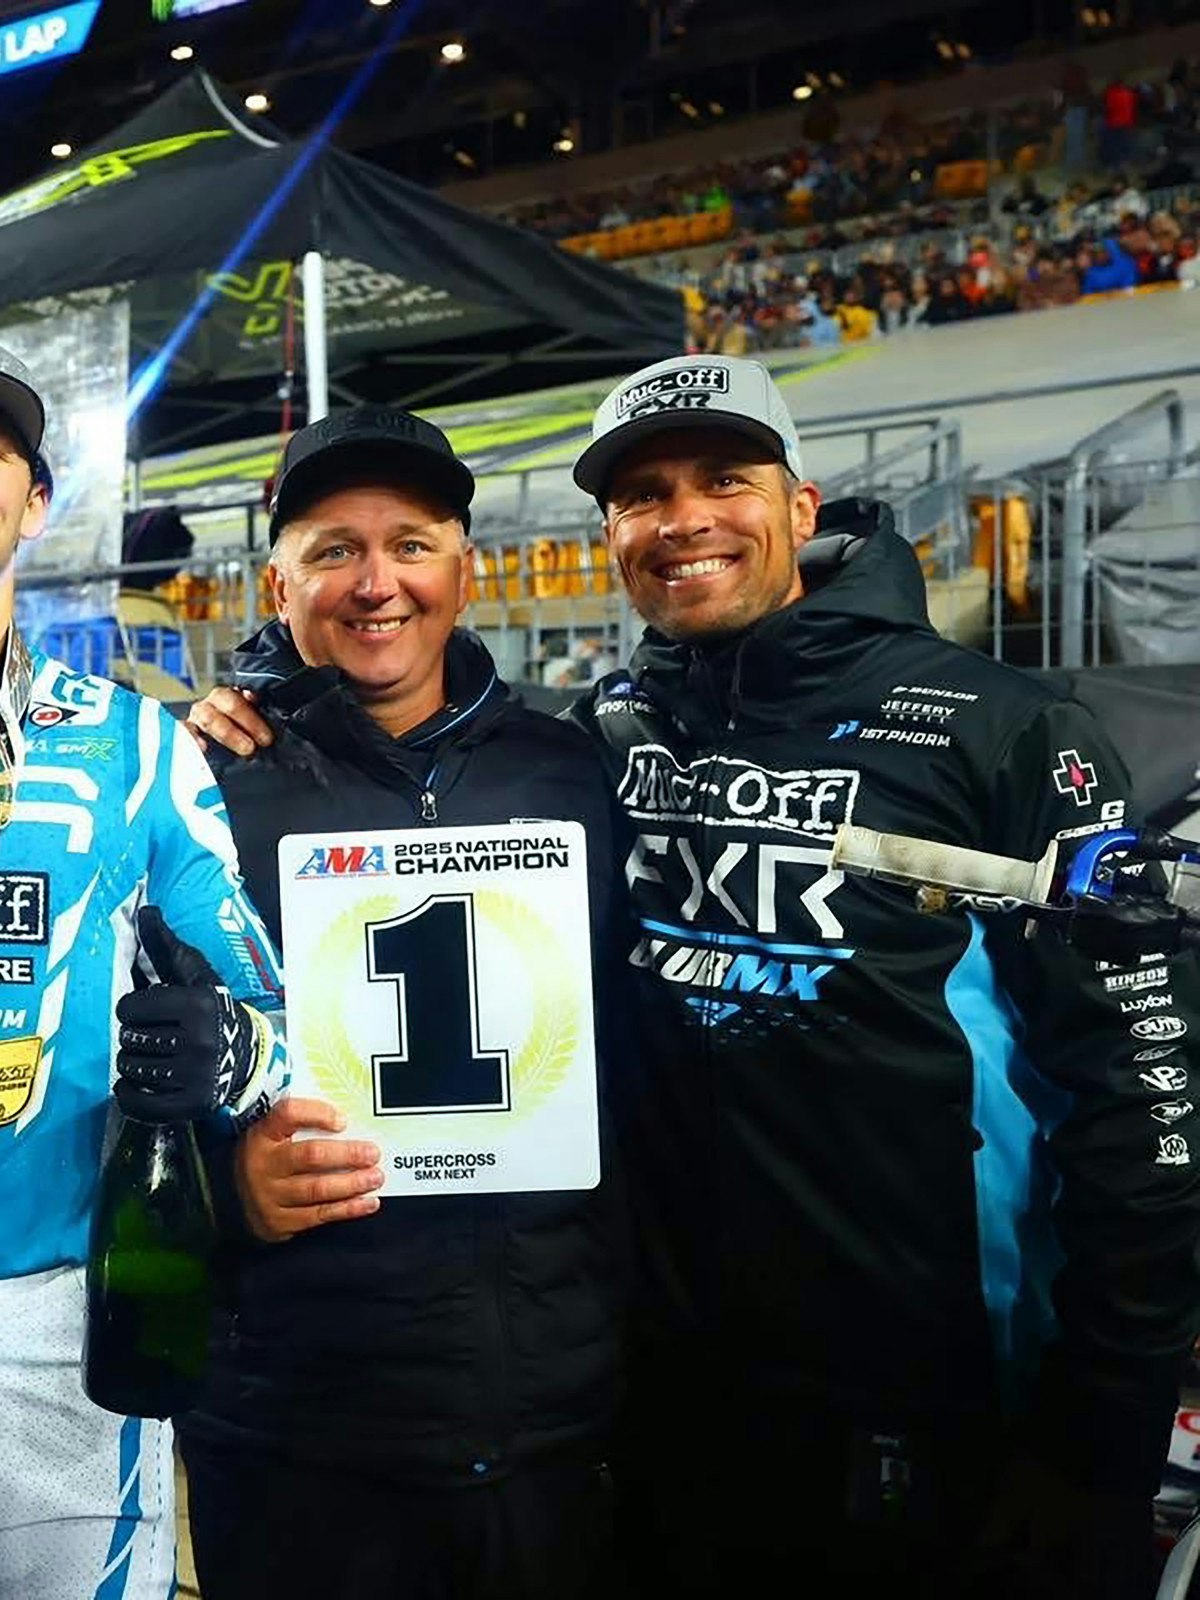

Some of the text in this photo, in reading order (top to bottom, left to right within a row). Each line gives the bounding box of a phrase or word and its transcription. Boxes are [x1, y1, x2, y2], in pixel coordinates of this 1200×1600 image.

[5, 16, 67, 62] LAP
[622, 368, 721, 407] Muc-Off
[880, 700, 956, 716] JEFFERY
[624, 757, 846, 831] Muc-Off
[394, 836, 569, 857] 2025 NATIONAL
[297, 844, 388, 876] AMA
[394, 851, 570, 876] CHAMPION
[1105, 966, 1168, 988] HINSON
[365, 893, 511, 1116] 1
[1120, 994, 1173, 1013] LUXON
[393, 1152, 497, 1170] SUPERCROSS
[414, 1168, 476, 1181] SMX NEXT
